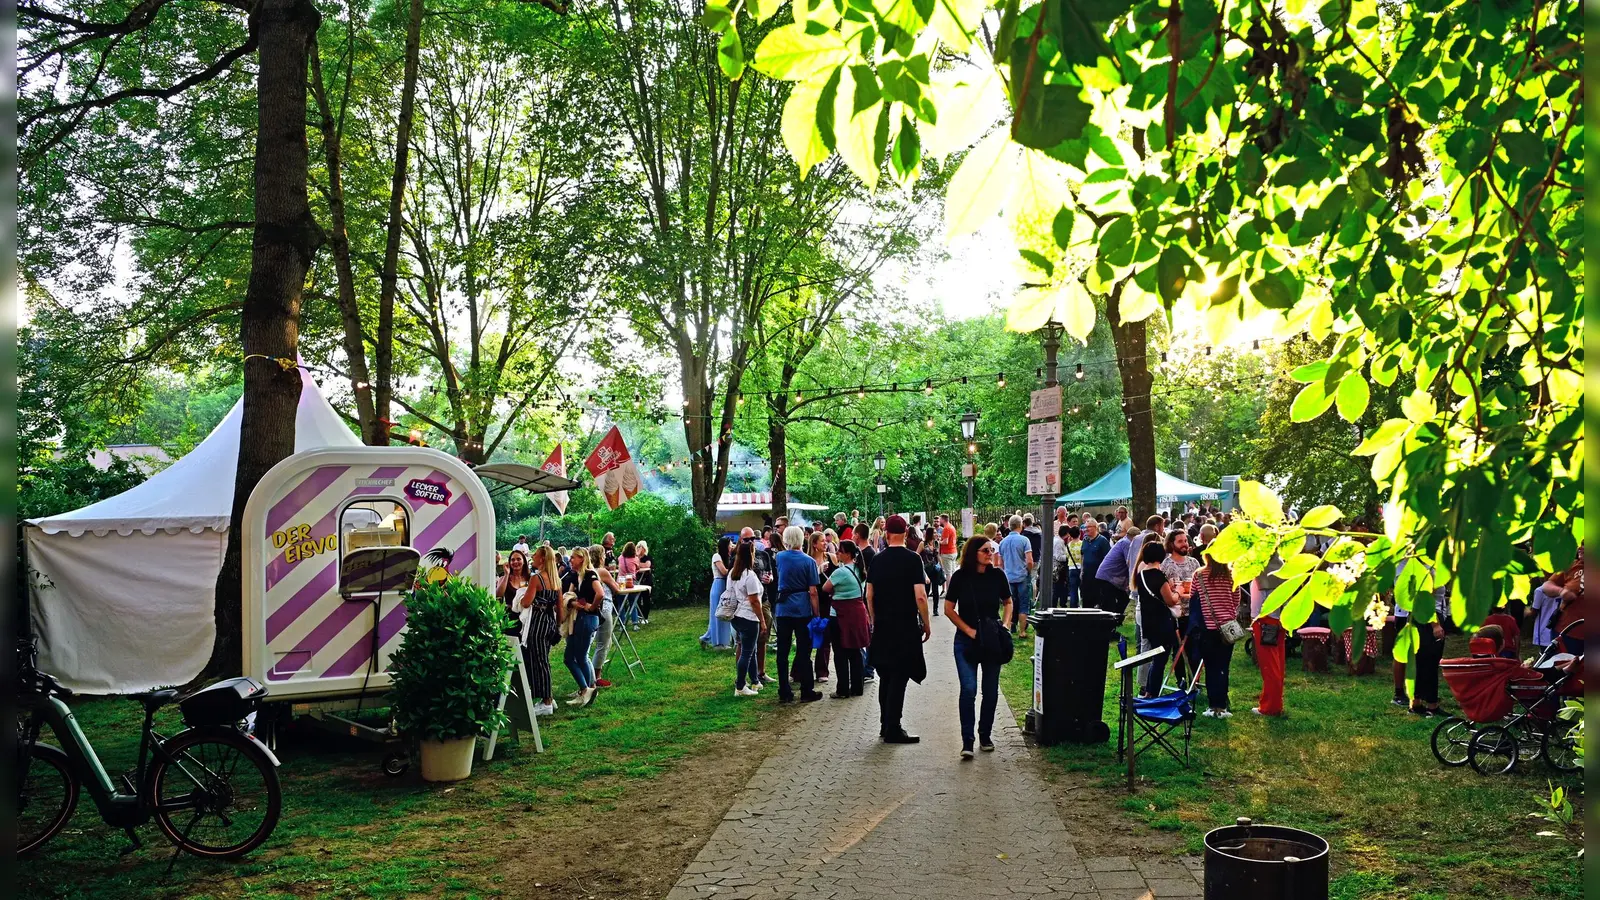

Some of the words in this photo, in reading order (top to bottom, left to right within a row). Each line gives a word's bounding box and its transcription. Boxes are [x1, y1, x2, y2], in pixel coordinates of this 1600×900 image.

[411, 481, 439, 493] LECKER
[414, 489, 445, 502] SOFTEIS
[1159, 495, 1179, 503] FISCHER
[1200, 493, 1219, 501] FISCHER
[272, 523, 312, 549] DER
